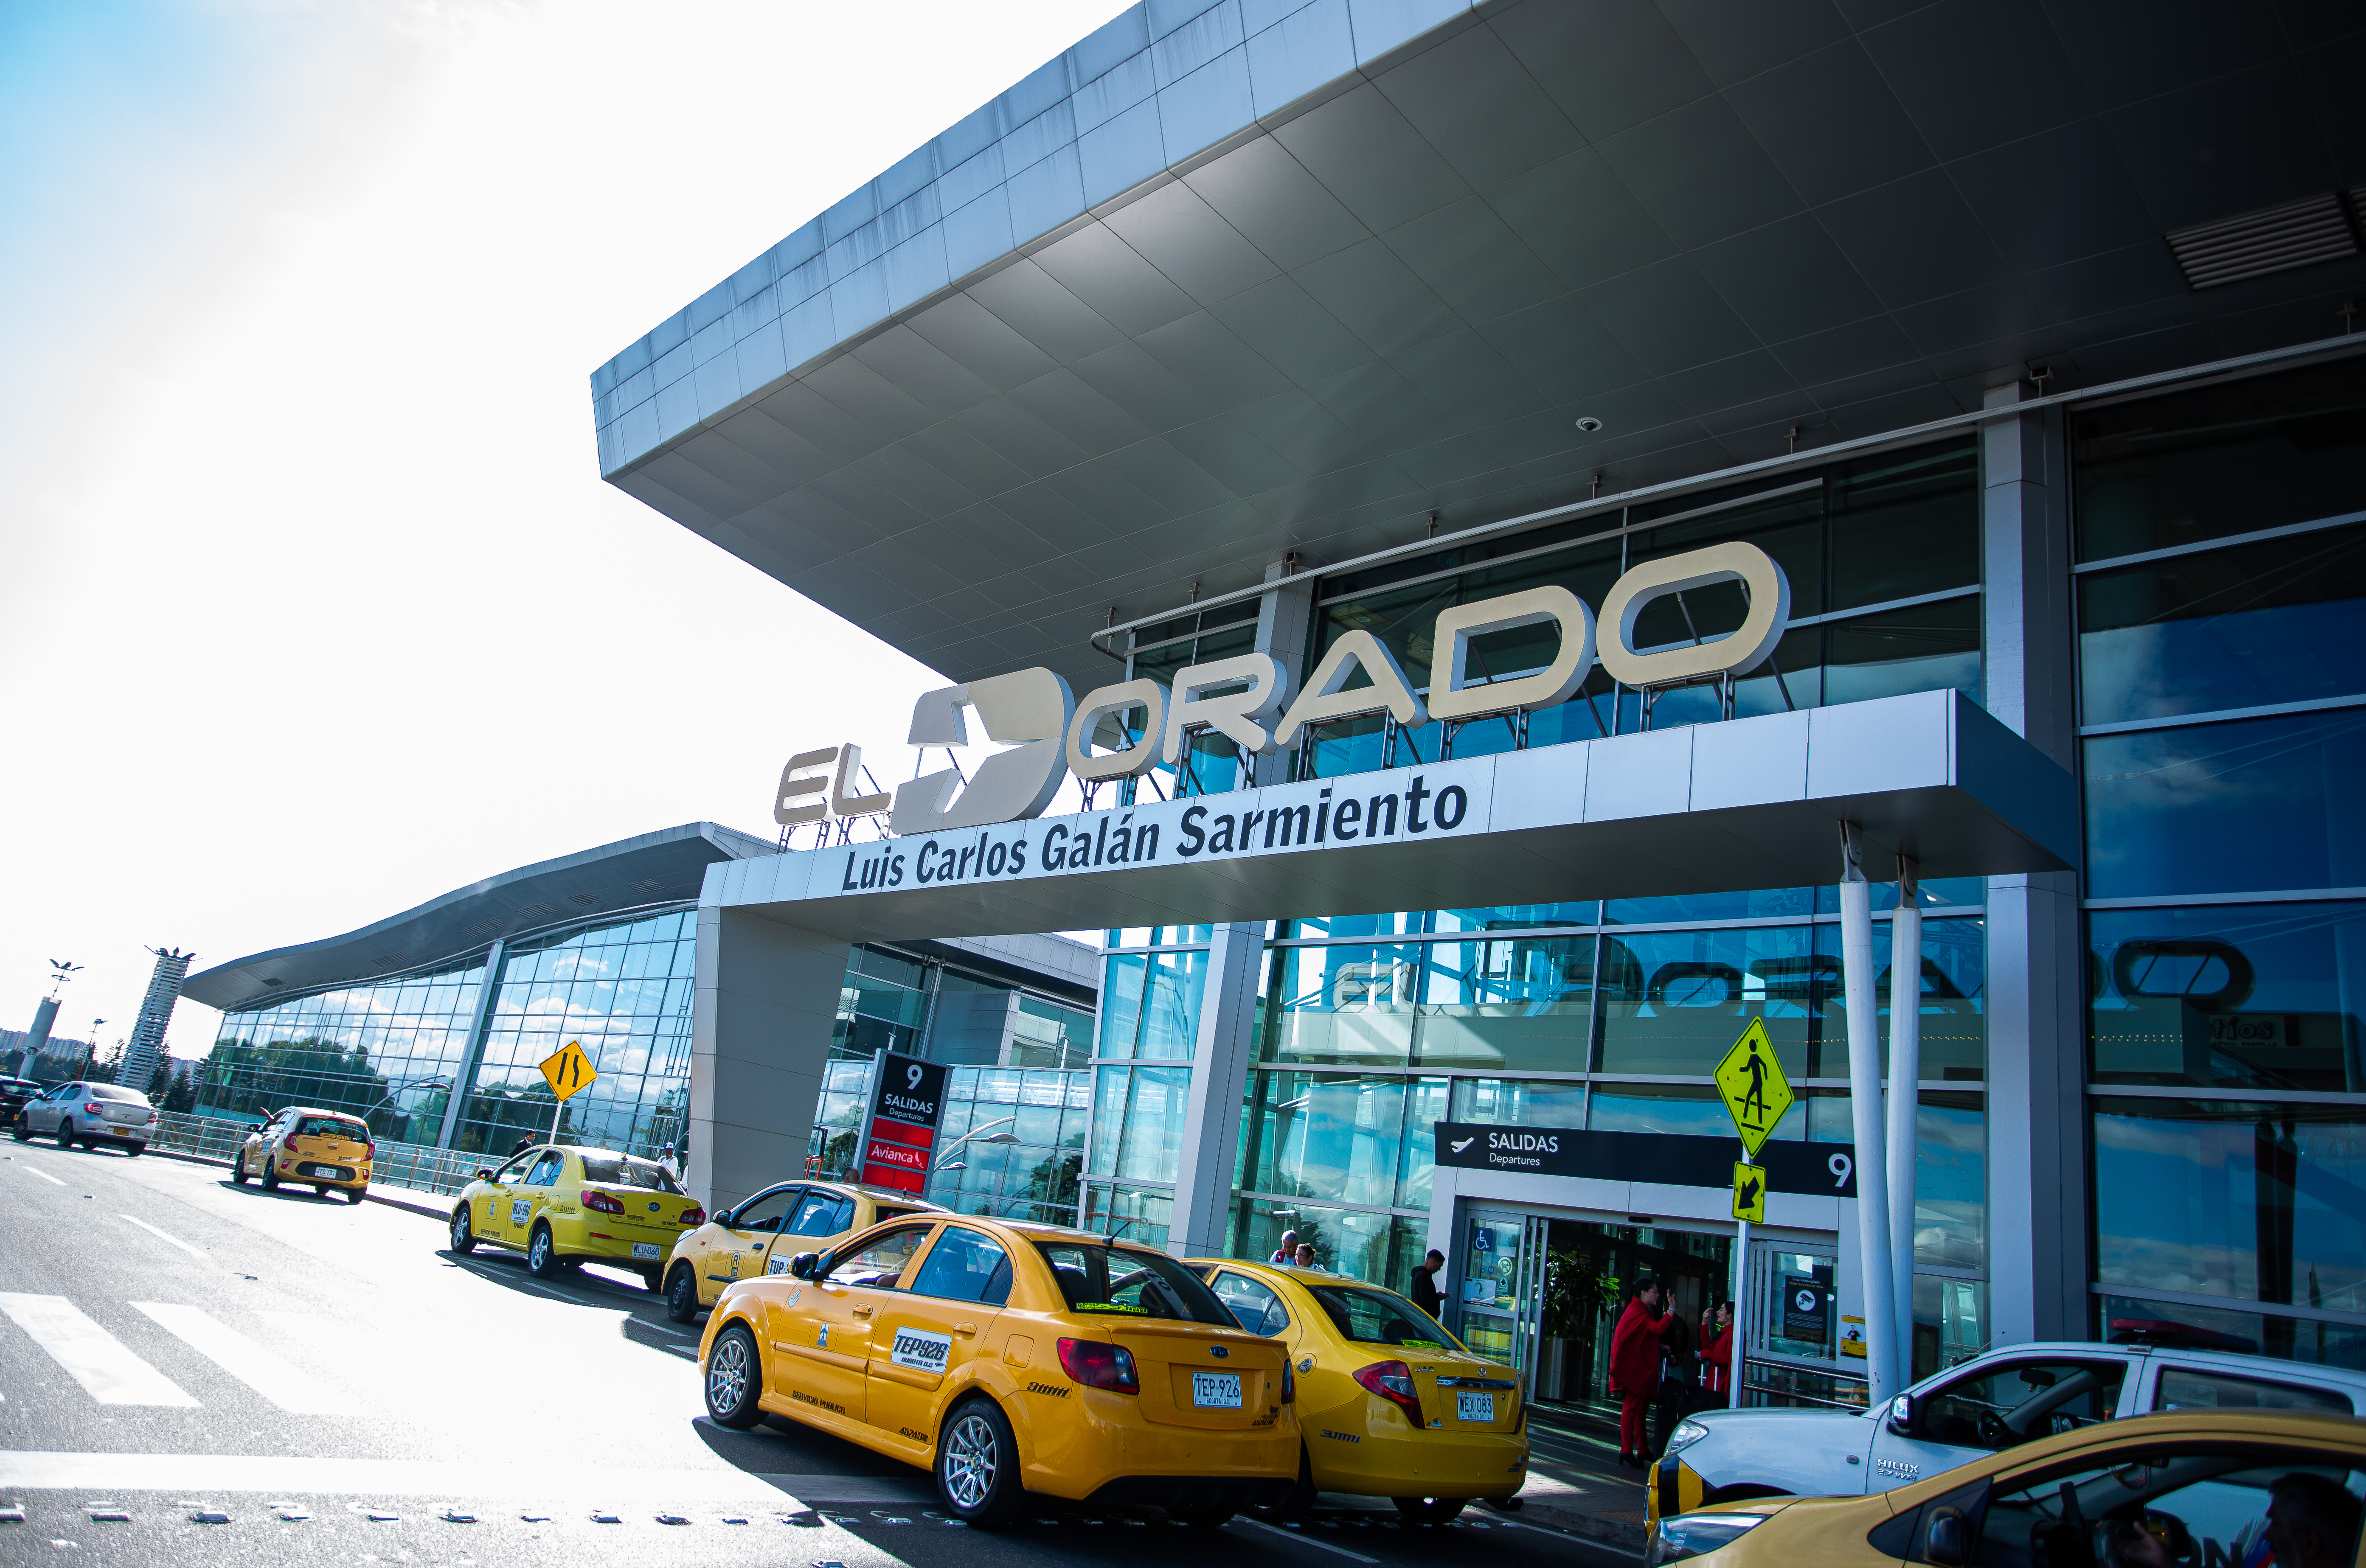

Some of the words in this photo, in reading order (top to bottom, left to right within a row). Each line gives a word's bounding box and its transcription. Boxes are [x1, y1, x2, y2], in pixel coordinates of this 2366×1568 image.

[774, 742, 891, 825] EL
[890, 541, 1790, 836] DORADO
[842, 843, 905, 892] Luis
[916, 833, 1026, 884] Carlos
[1041, 812, 1161, 872] Galán
[1176, 774, 1467, 857] Sarmiento
[907, 1064, 922, 1090] 9
[885, 1094, 933, 1114] SALIDAS
[889, 1108, 924, 1121] Departures
[1489, 1132, 1558, 1152] SALIDAS
[871, 1145, 913, 1163] Avianca
[1489, 1153, 1540, 1166] Departures
[1828, 1153, 1852, 1187] 9
[894, 1335, 948, 1360] TEP926
[792, 1390, 819, 1405] SERVICIO
[819, 1399, 846, 1414] PUBLICO
[1877, 1458, 1919, 1474] HILUX
